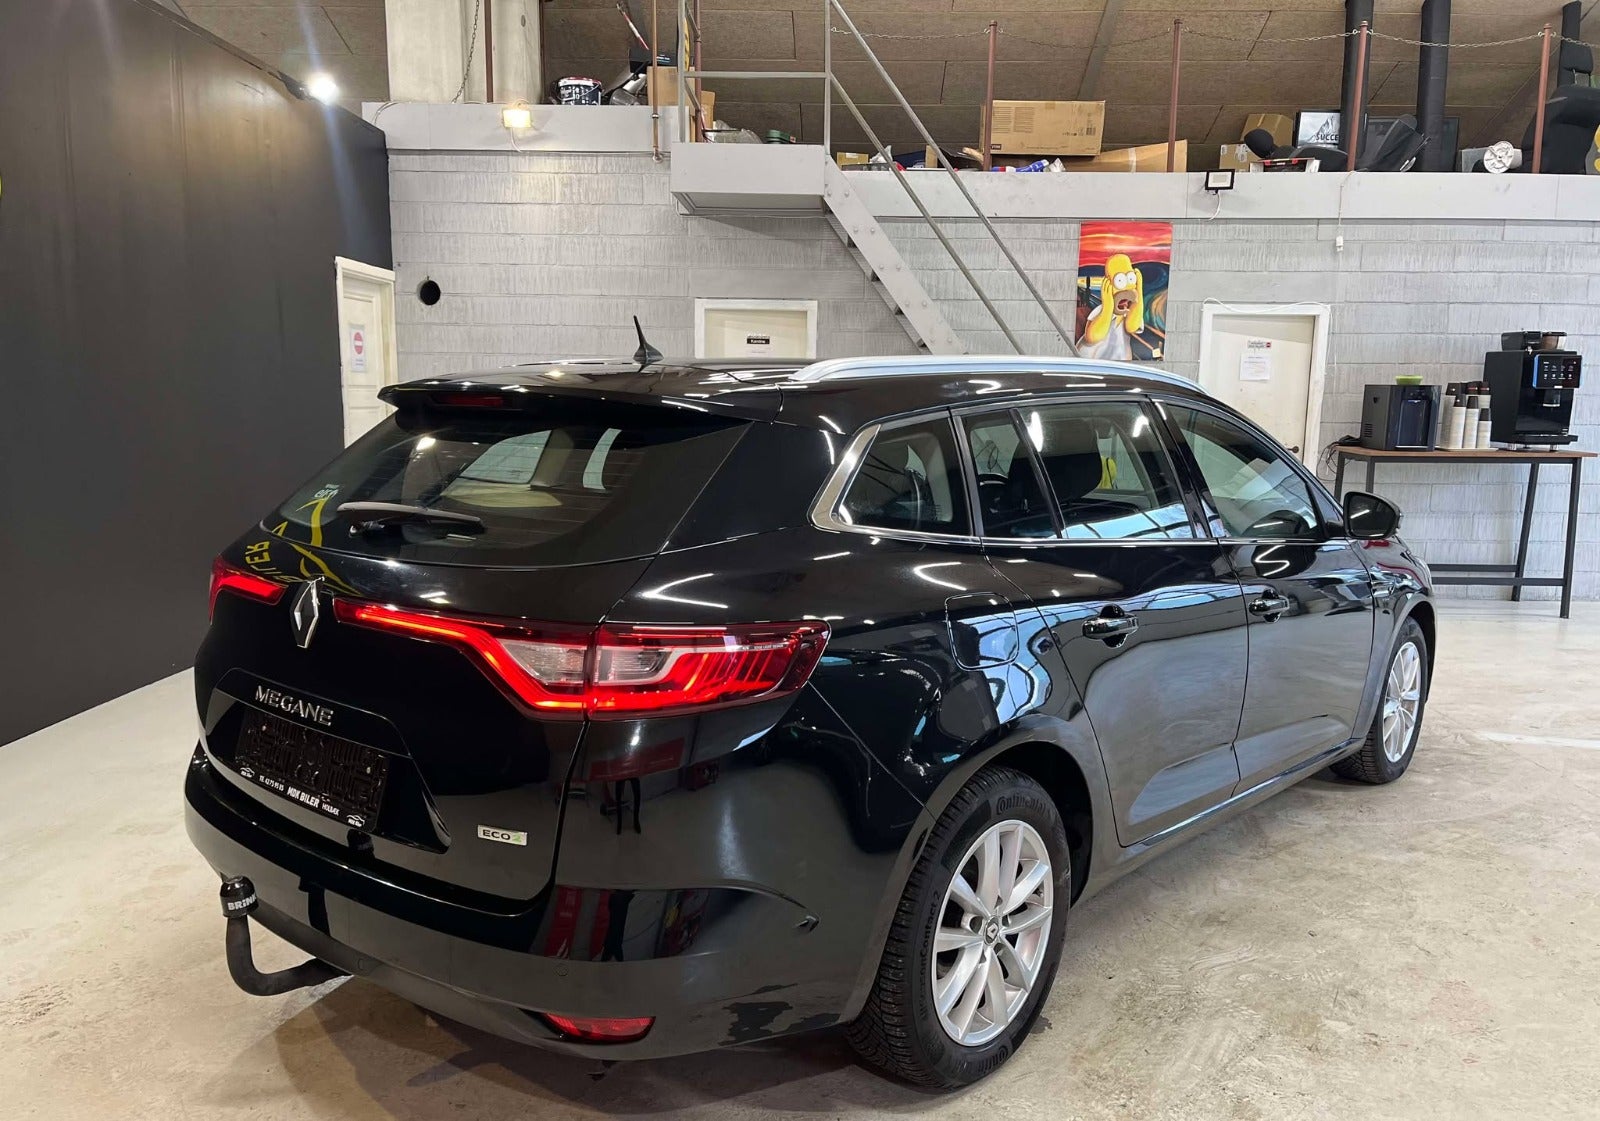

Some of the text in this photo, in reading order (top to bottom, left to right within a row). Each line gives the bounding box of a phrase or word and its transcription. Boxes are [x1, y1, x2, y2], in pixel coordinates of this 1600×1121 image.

[1316, 133, 1340, 141] SUCCE
[255, 685, 334, 726] MEGANE
[287, 786, 300, 800] MDK
[300, 792, 320, 808] BILER
[482, 829, 522, 843] ECO2
